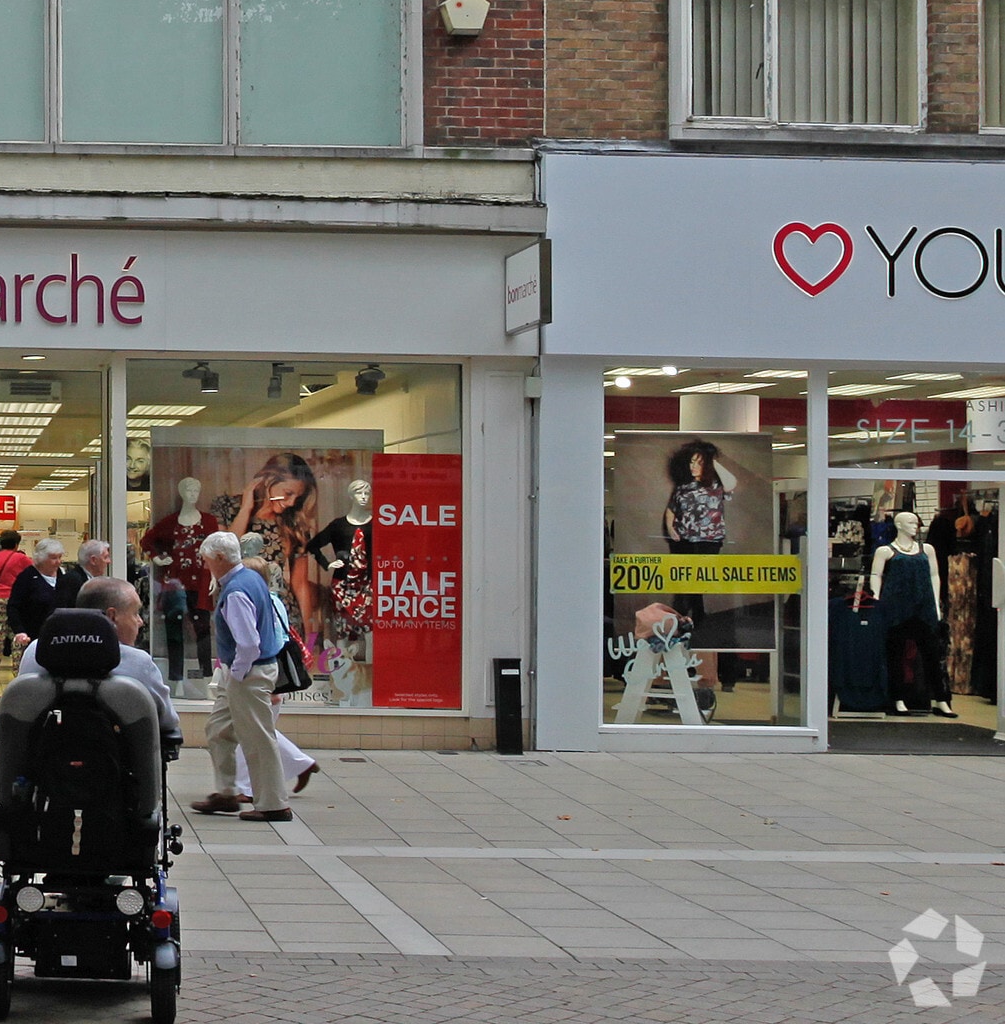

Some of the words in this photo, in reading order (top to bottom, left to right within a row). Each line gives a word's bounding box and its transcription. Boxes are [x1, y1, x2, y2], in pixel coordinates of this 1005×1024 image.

[864, 225, 1005, 299] YO
[856, 419, 930, 444] SIZE
[378, 504, 456, 526] SALE
[377, 560, 390, 569] UP
[392, 560, 405, 569] TO
[670, 567, 692, 581] OFF
[696, 567, 719, 582] ALL
[723, 567, 754, 582] SALE
[758, 567, 796, 582] ITEMS
[377, 571, 456, 596] HALF
[613, 565, 663, 590] 20%
[377, 596, 456, 618] PRICE
[378, 619, 393, 629] ON
[396, 619, 425, 629] MANY
[426, 620, 456, 630] ITEMS
[51, 635, 103, 645] ANIMAL
